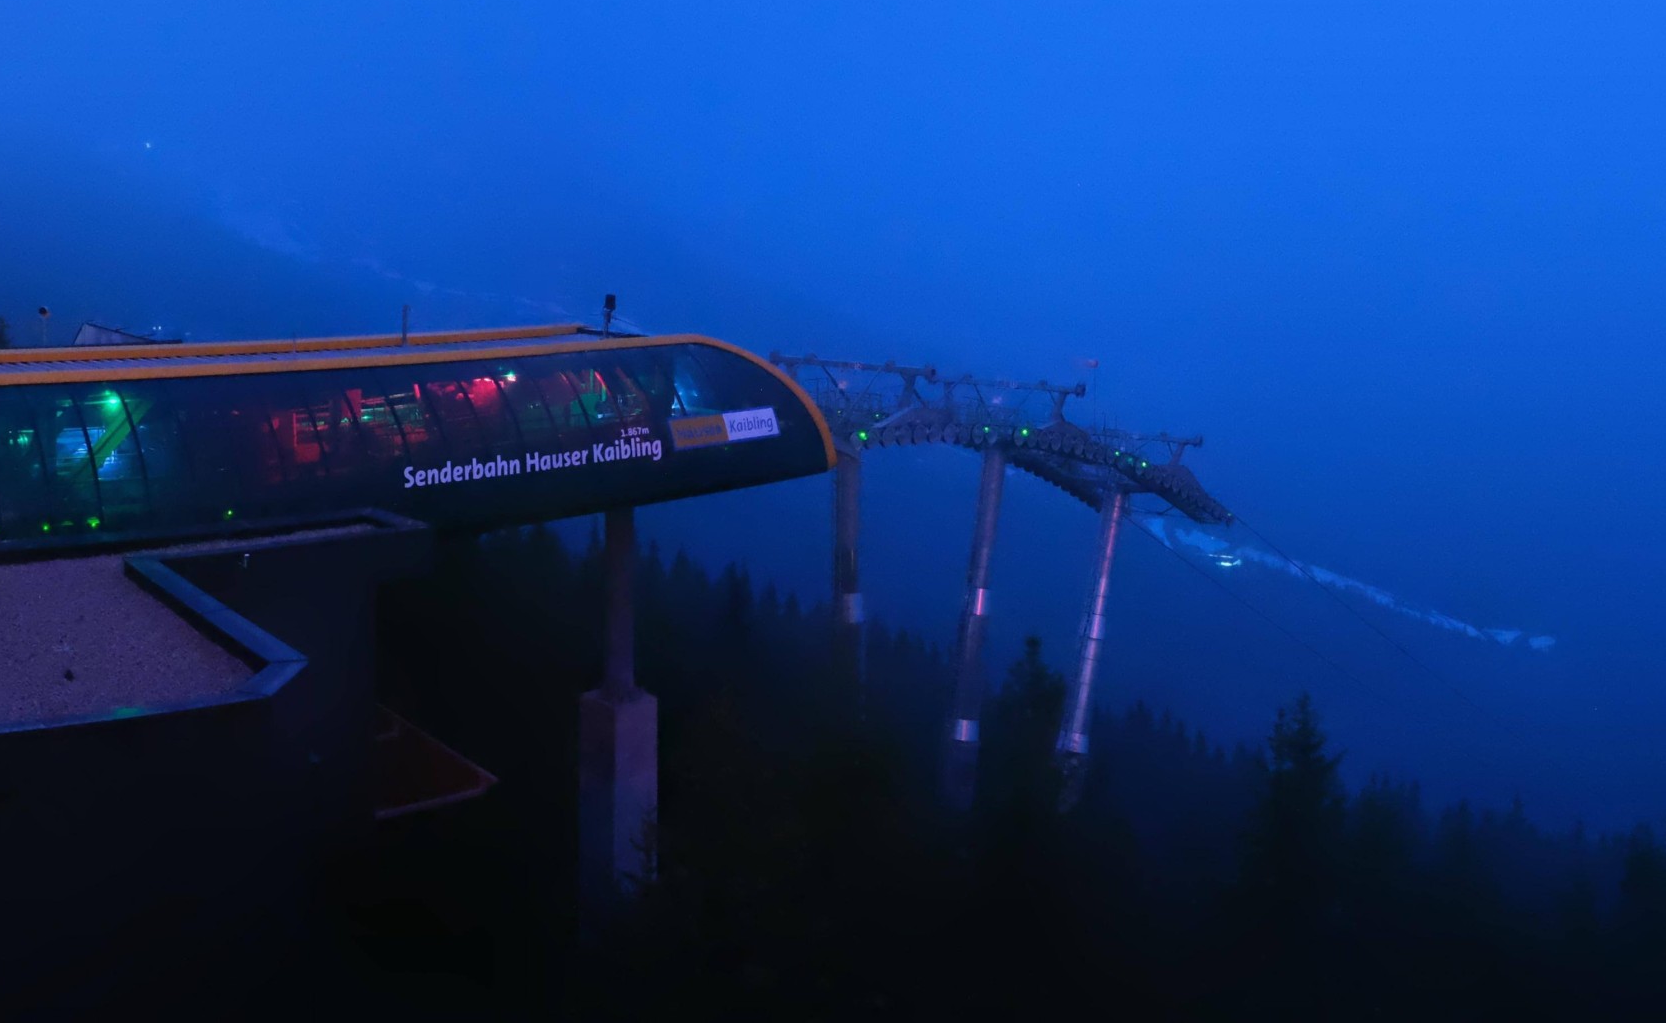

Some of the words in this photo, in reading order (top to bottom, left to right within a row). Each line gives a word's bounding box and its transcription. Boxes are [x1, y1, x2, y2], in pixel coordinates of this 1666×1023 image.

[620, 426, 650, 437] 1.867m
[729, 416, 774, 433] Kaibling
[403, 454, 521, 489] Senderbahn
[526, 451, 589, 473] Hauser
[592, 437, 663, 462] Kaibling
